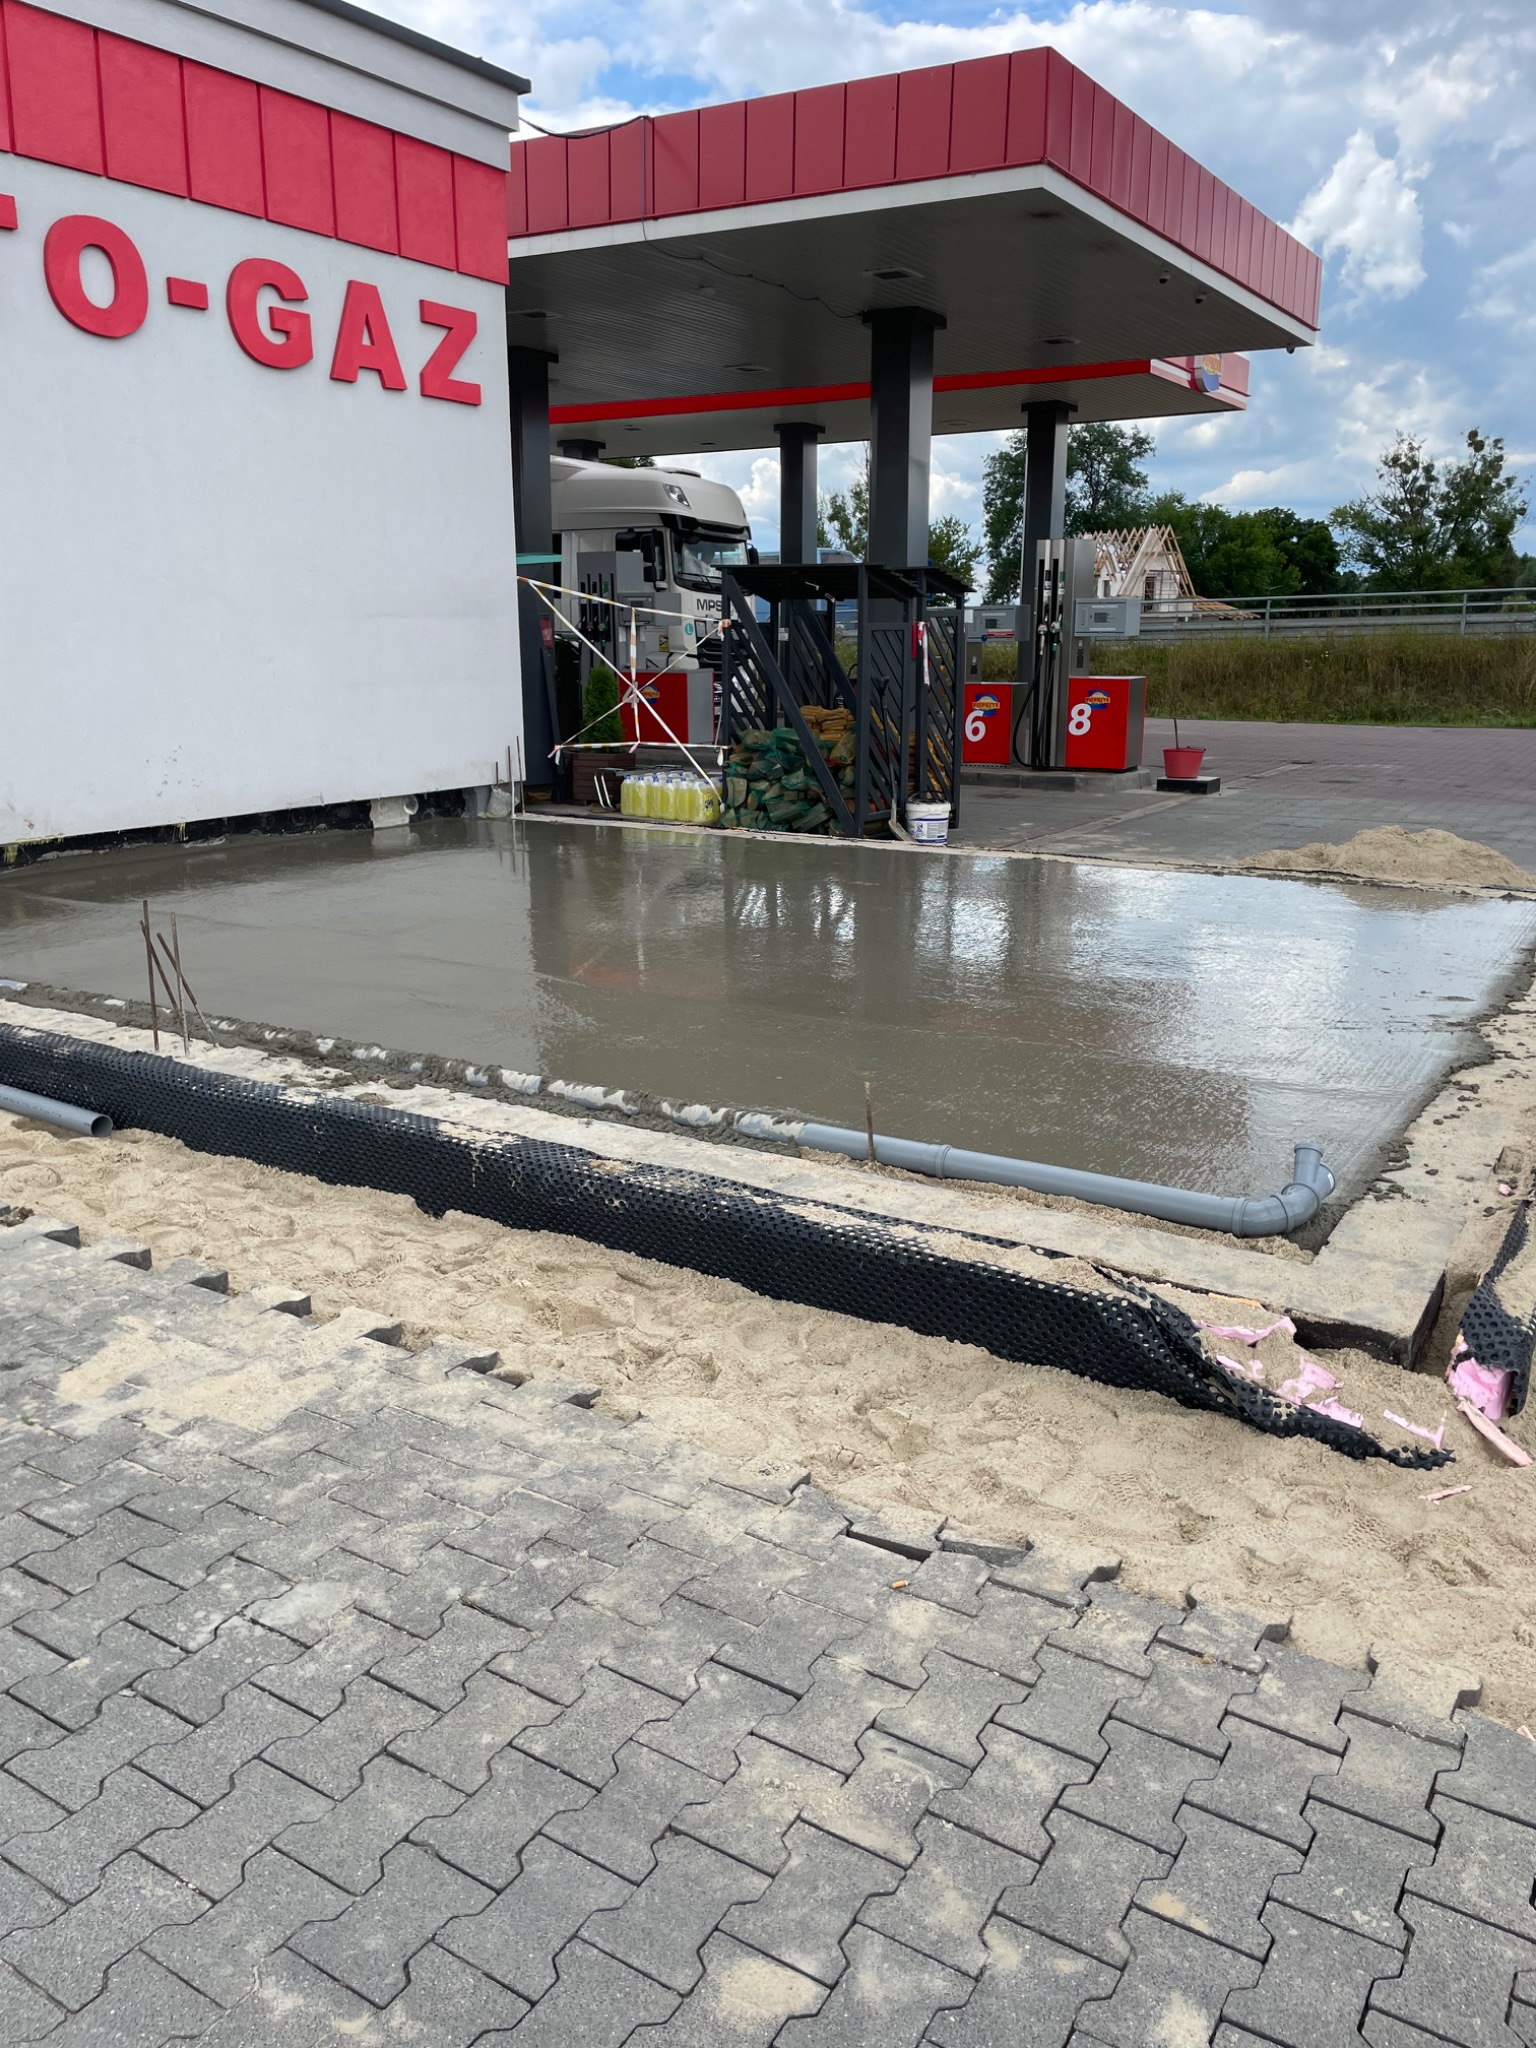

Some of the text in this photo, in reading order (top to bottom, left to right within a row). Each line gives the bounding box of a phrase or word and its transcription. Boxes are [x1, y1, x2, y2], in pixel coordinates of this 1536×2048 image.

[0, 194, 482, 406] O-GAZ
[965, 710, 986, 742] 6
[1068, 703, 1092, 736] 8
